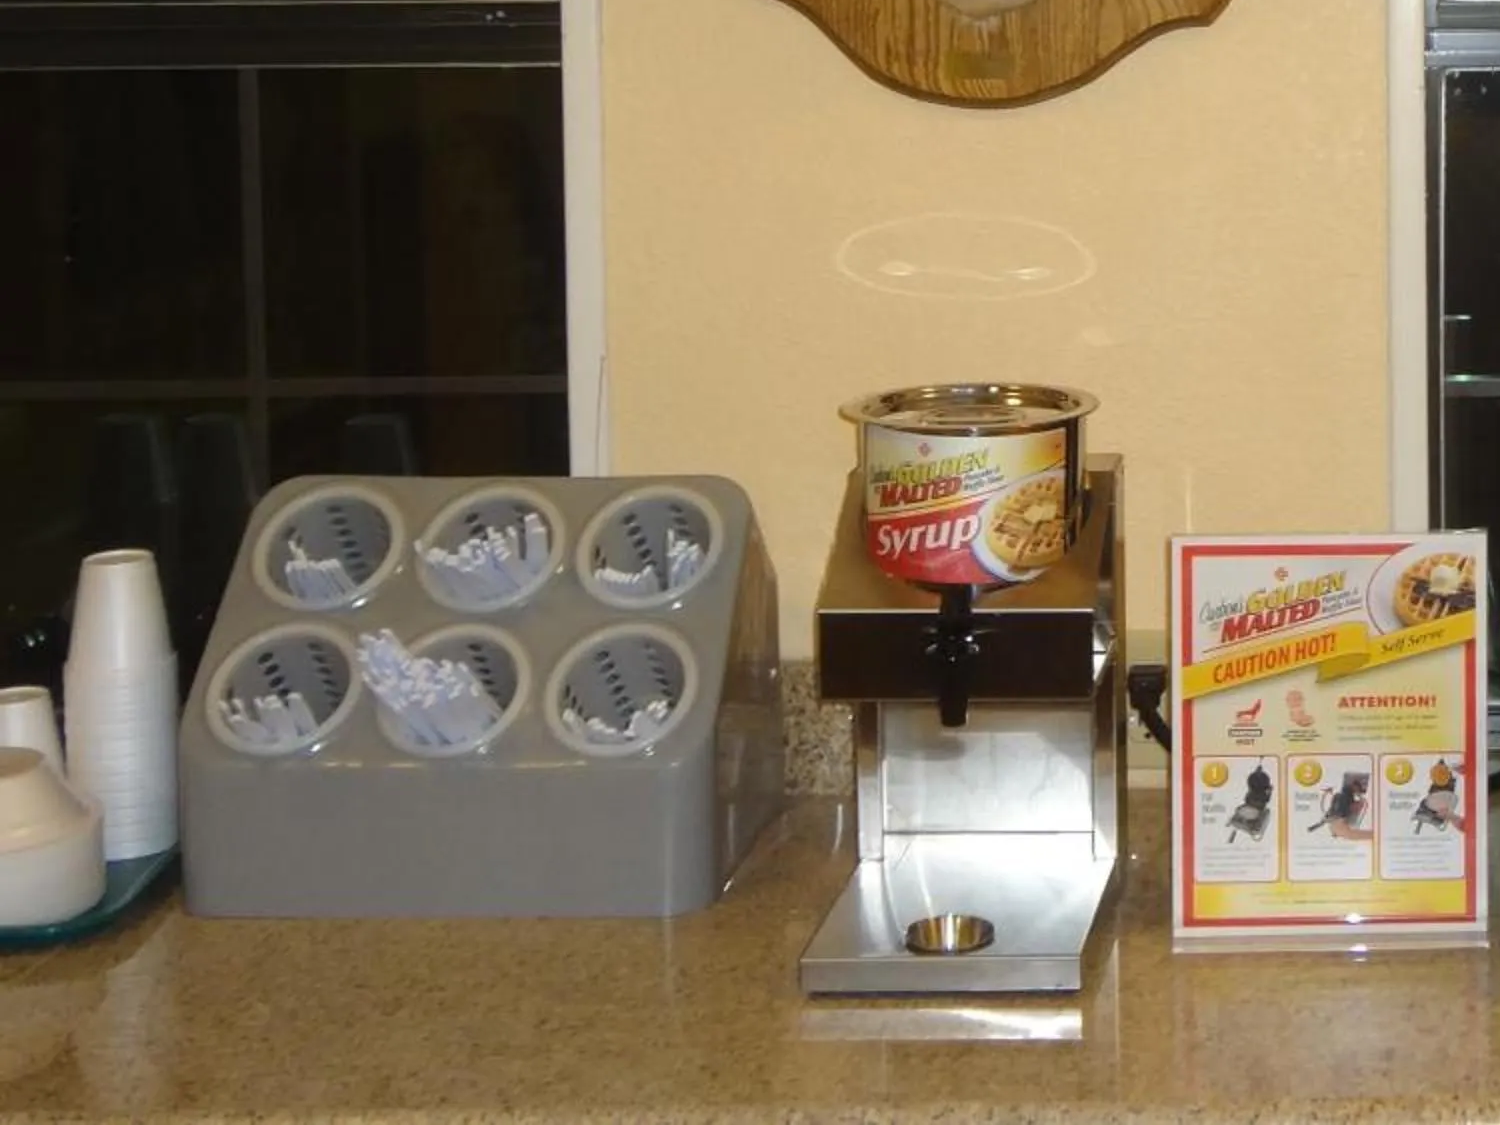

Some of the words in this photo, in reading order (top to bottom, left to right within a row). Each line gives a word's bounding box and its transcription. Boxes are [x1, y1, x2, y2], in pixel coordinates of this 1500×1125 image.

[877, 515, 980, 560] Syrup
[1221, 598, 1321, 643] MALTED
[1381, 638, 1406, 654] Self
[1407, 628, 1446, 648] Serve
[1213, 647, 1292, 683] CAUTION
[1295, 632, 1337, 662] HOT!
[1337, 696, 1438, 709] ATTENTION!
